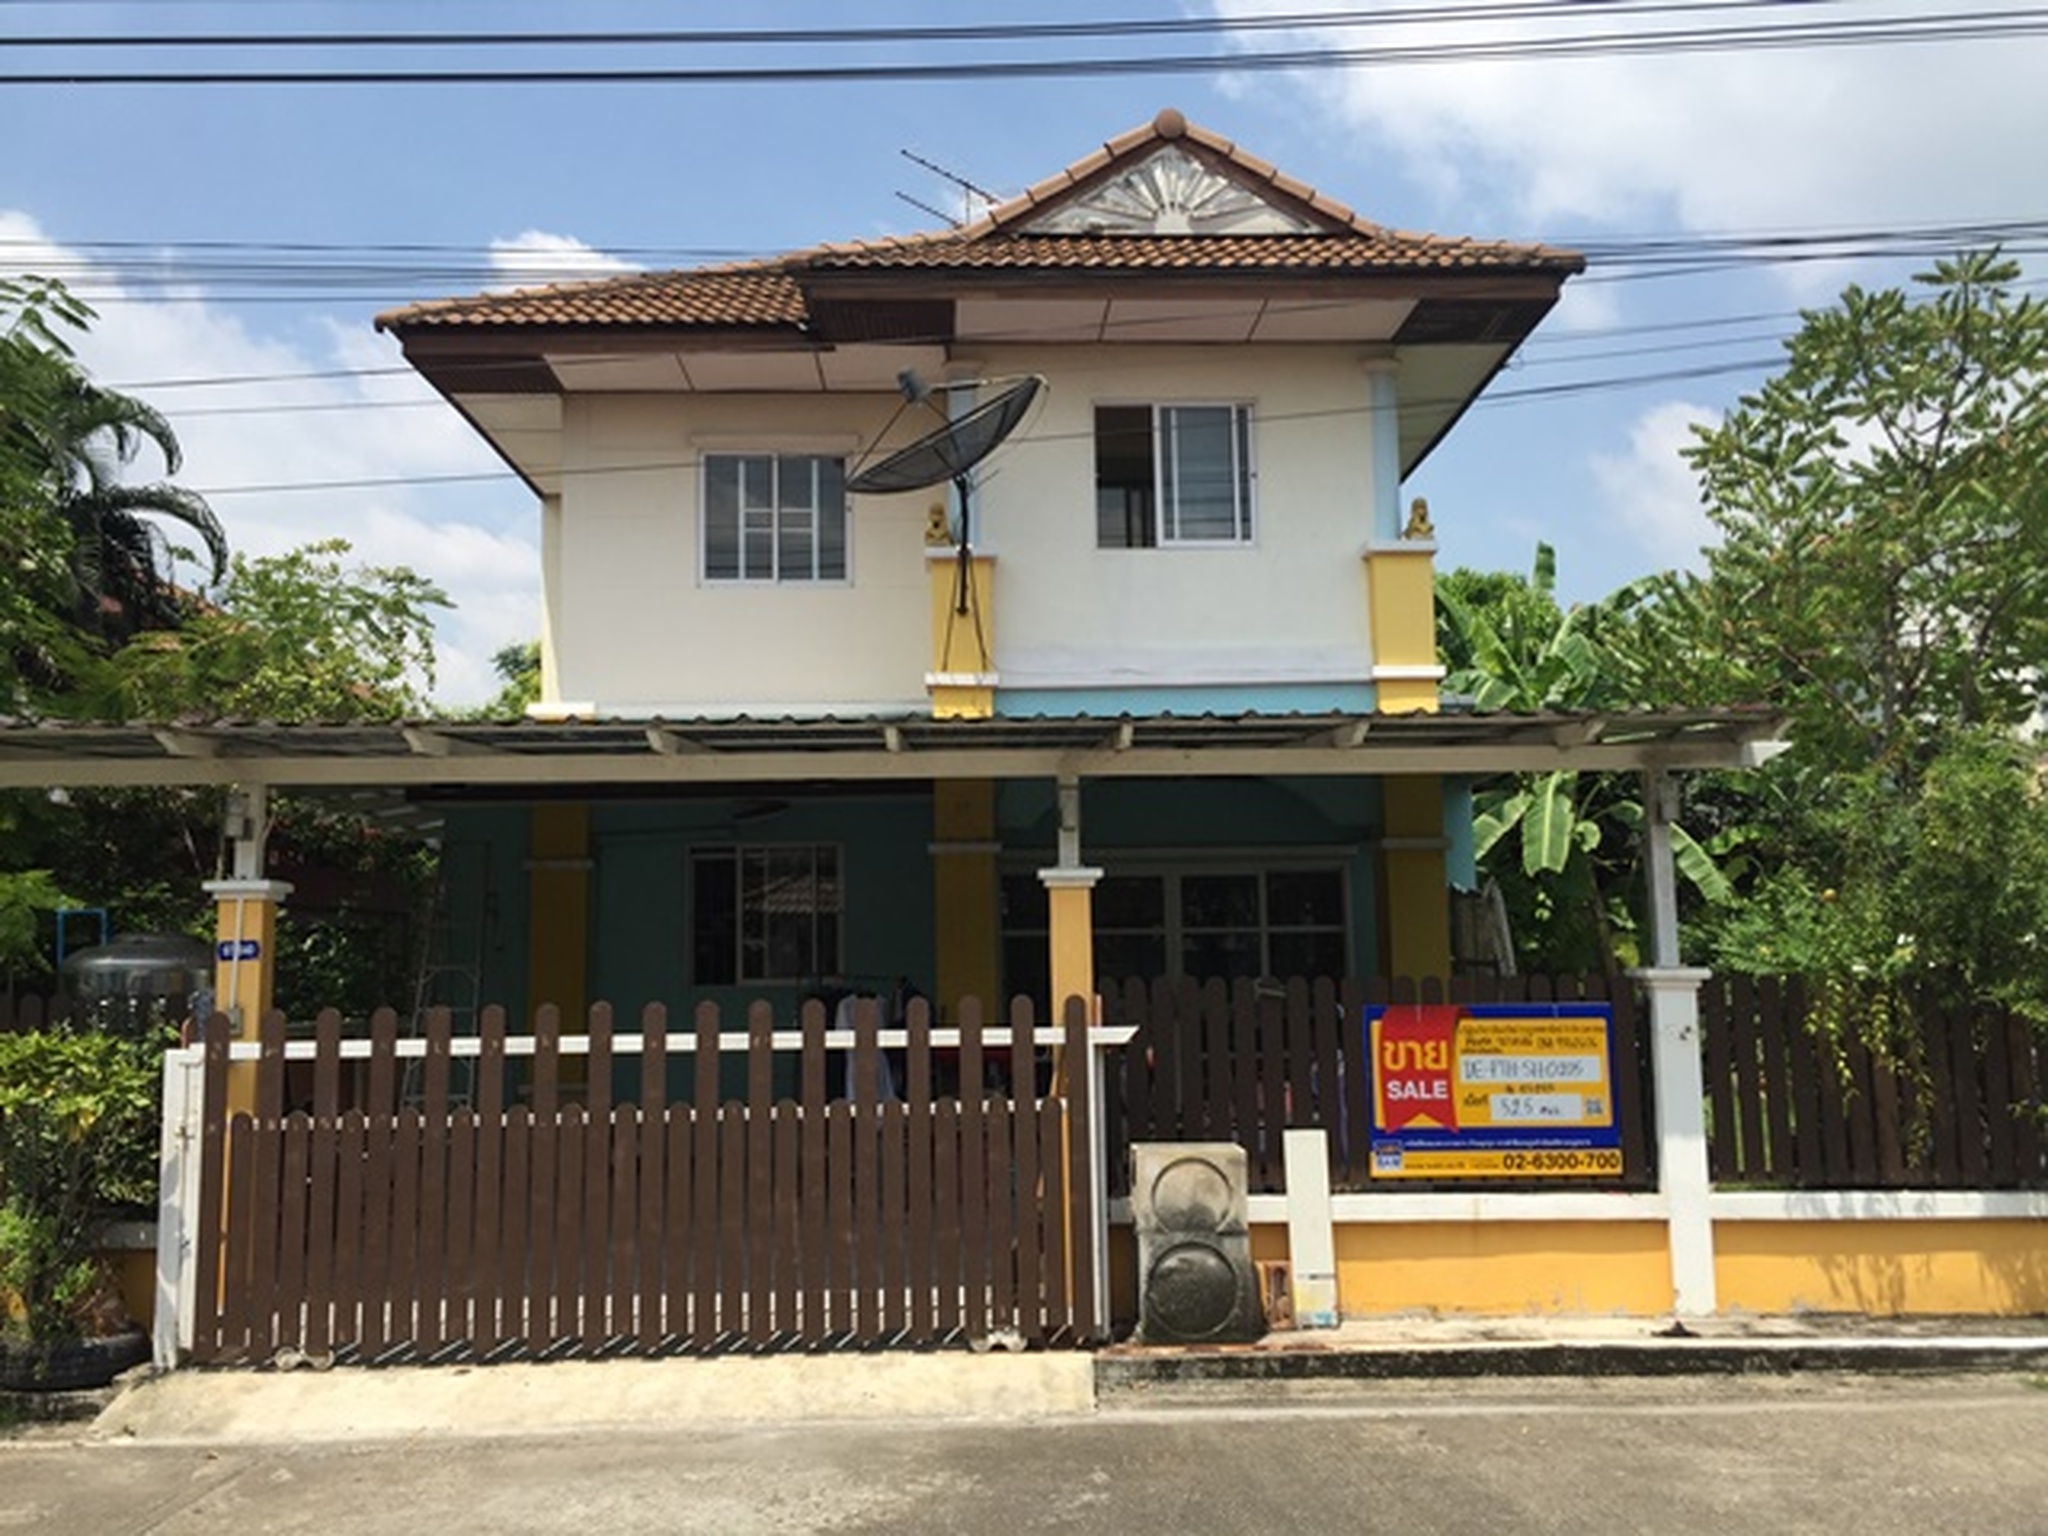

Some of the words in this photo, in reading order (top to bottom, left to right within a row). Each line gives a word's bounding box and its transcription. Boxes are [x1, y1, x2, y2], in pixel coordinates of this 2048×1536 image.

[1383, 1040, 1448, 1071] ขาย
[1387, 1080, 1449, 1100] SALE
[1502, 1153, 1620, 1170] 02-6300-700
